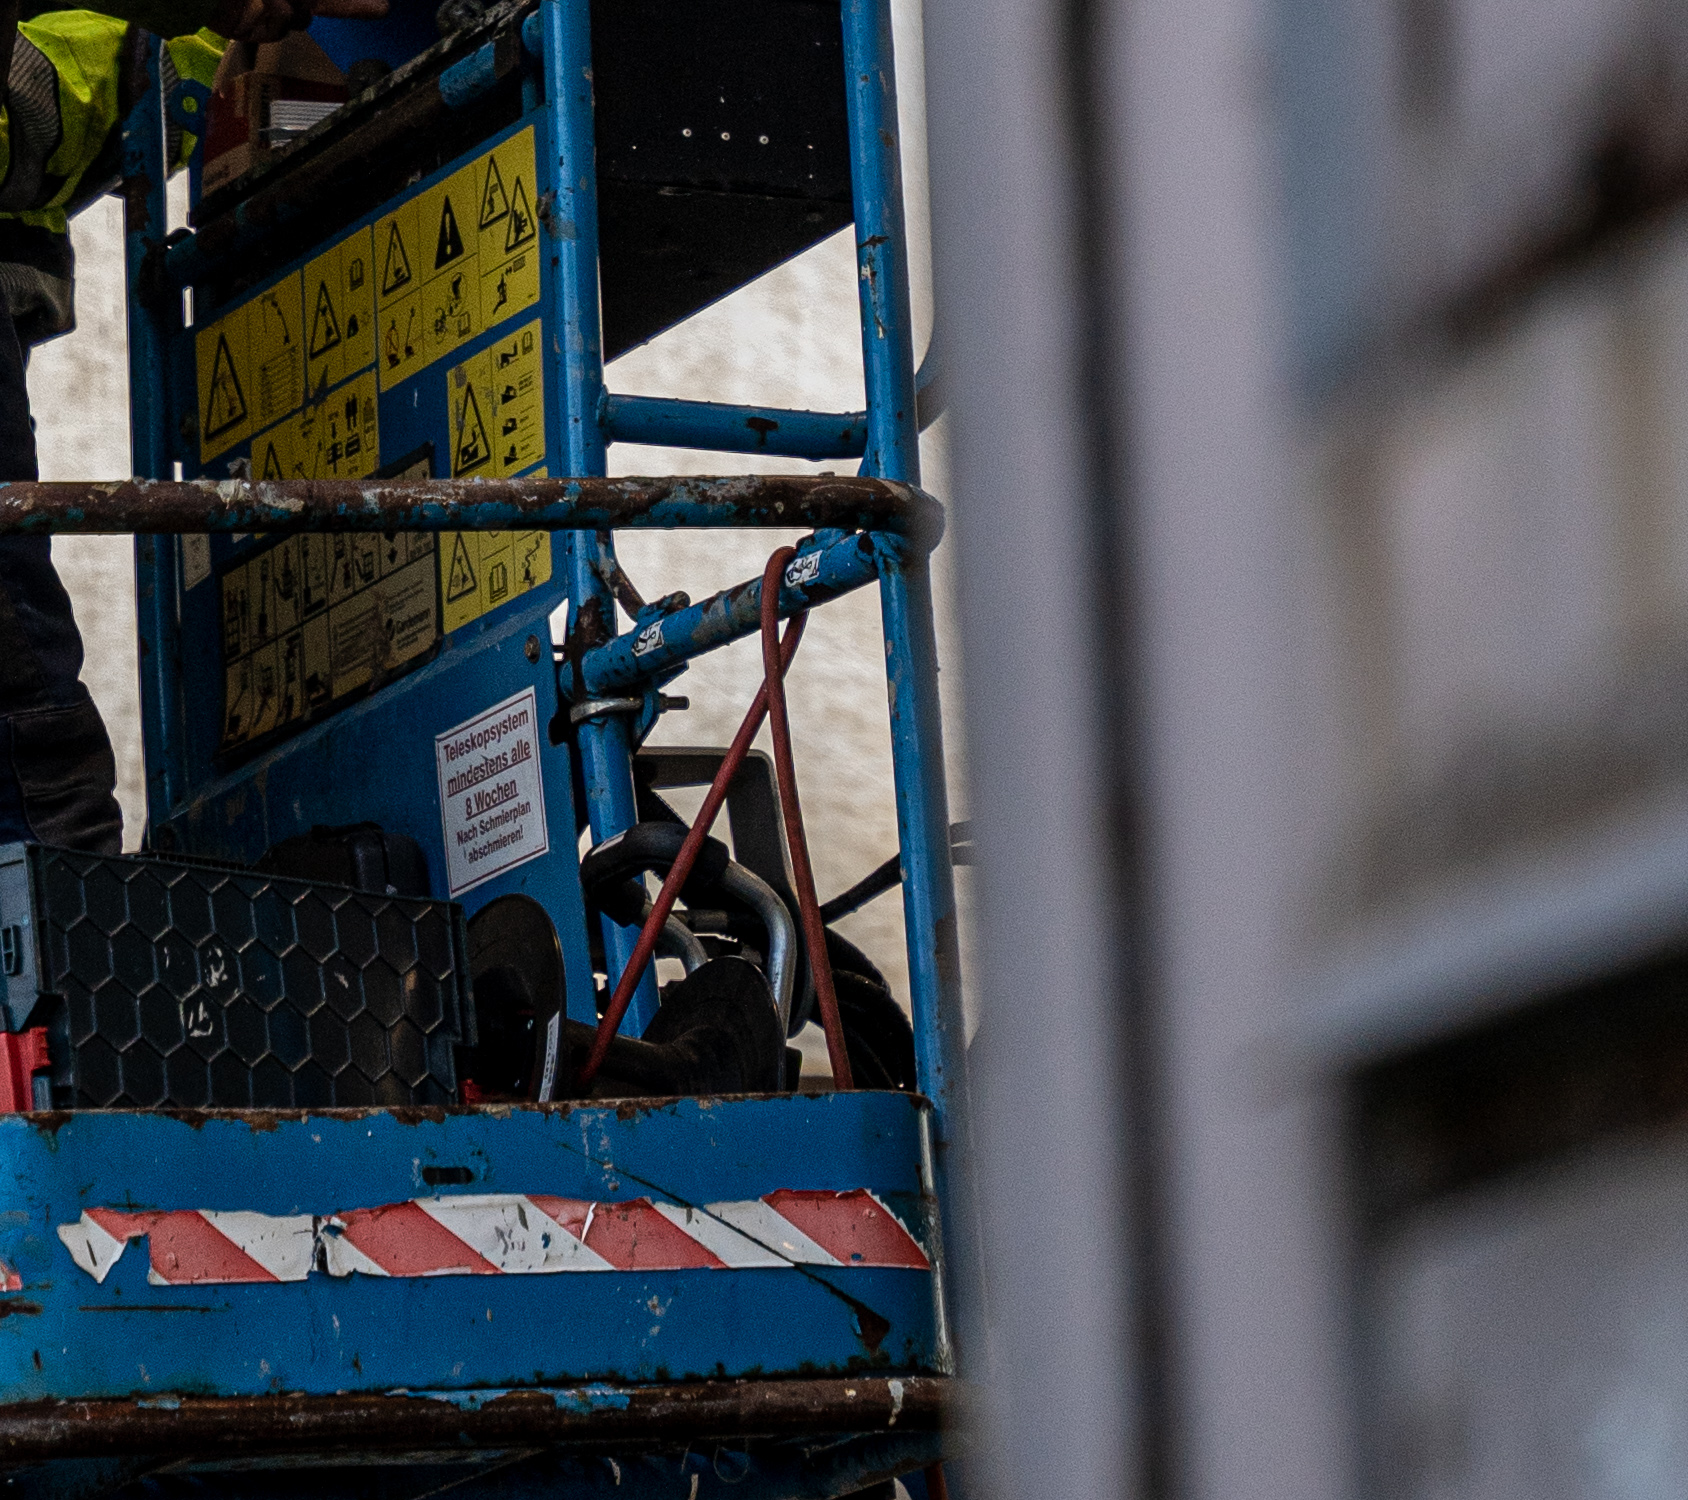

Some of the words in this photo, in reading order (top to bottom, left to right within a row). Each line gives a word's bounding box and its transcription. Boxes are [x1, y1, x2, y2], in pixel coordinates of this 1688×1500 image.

[444, 709, 529, 763] Teleskopsystem
[447, 752, 509, 796] mindestens
[511, 739, 531, 763] alle
[465, 797, 473, 817] 8
[474, 779, 517, 812] Wochen
[456, 825, 478, 847] Nach
[479, 800, 531, 835] Schmierplan
[467, 824, 524, 864] abschmieren!
